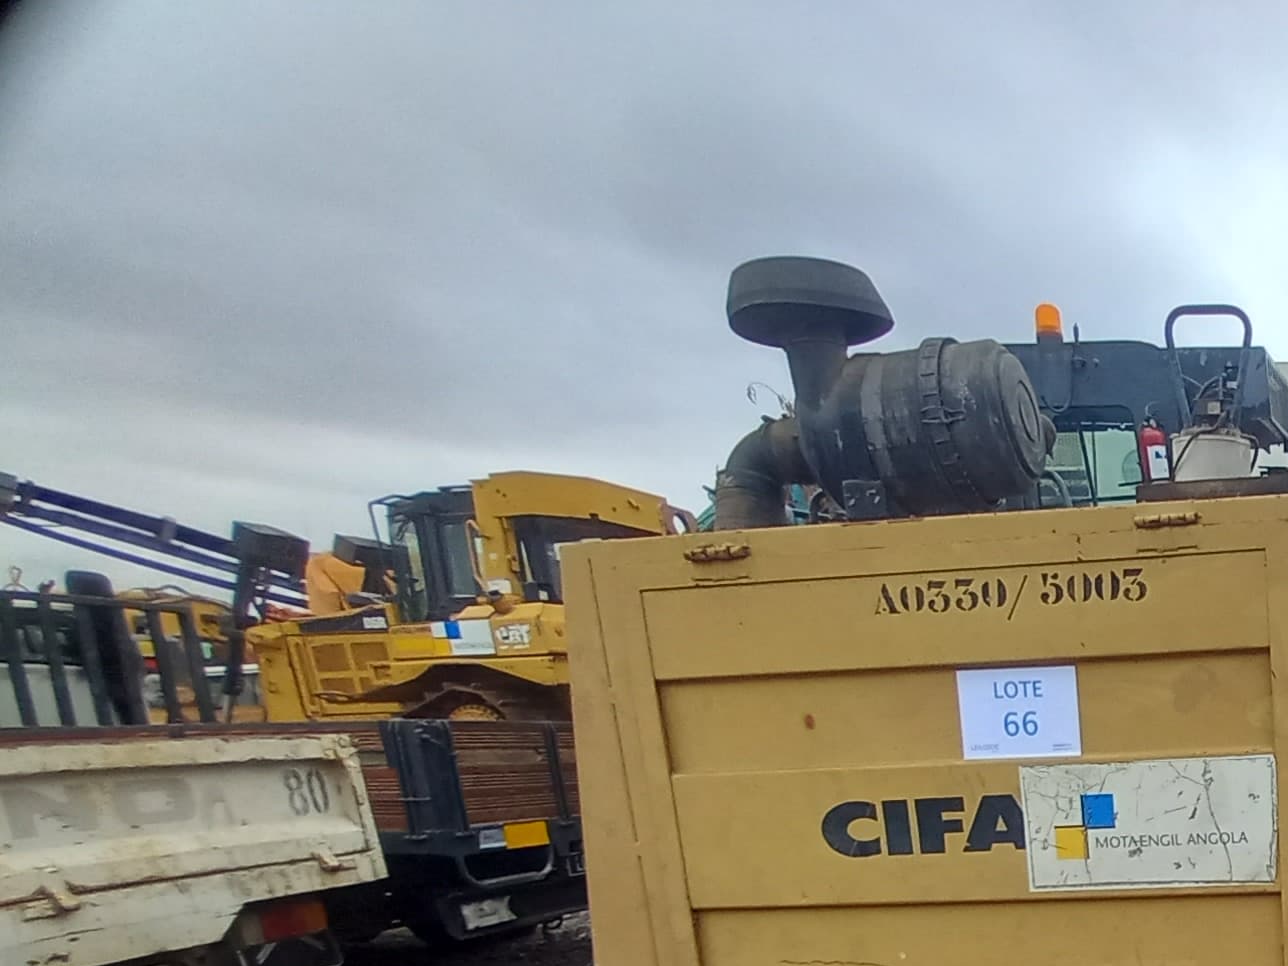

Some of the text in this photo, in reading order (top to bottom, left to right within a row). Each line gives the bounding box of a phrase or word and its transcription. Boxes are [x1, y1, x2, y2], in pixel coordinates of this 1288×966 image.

[993, 680, 1043, 699] LOTE
[1003, 711, 1038, 737] 66
[284, 767, 330, 816] 80
[821, 794, 1026, 858] CIFA
[1187, 831, 1249, 846] ANGOLA
